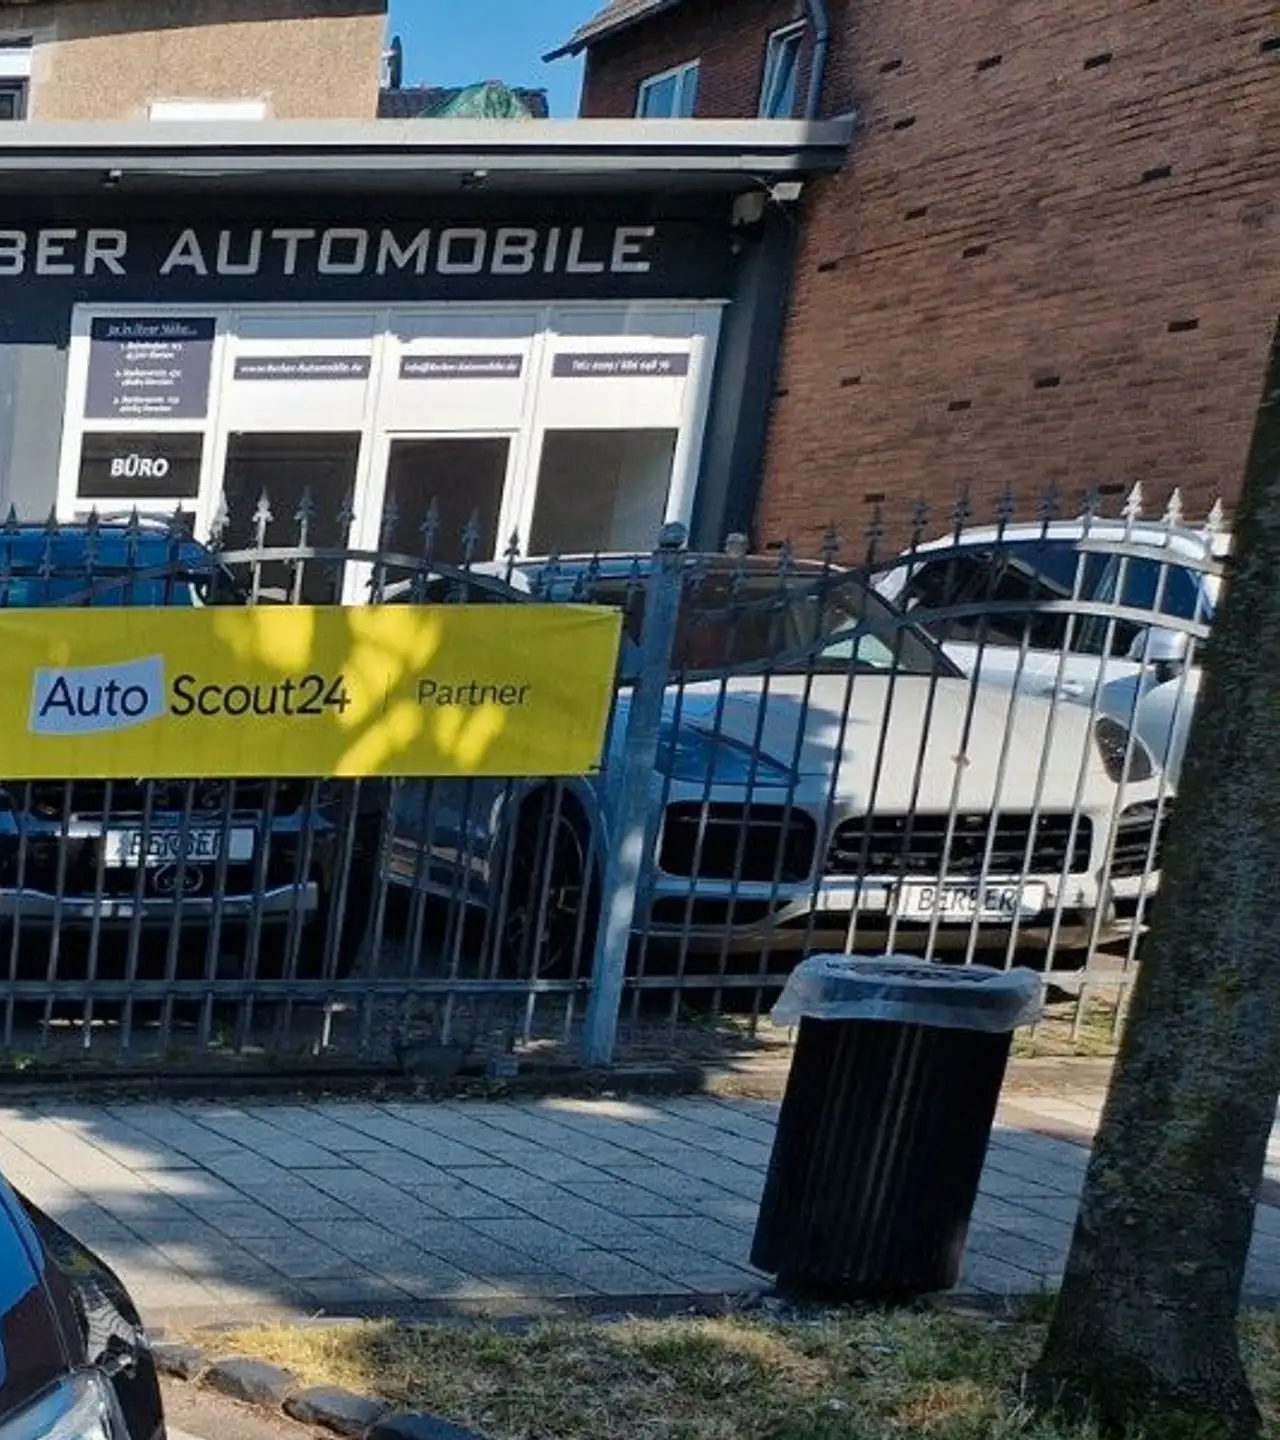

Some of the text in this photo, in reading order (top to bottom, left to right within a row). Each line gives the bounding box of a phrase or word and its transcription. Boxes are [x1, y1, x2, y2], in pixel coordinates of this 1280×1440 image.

[158, 225, 657, 276] AUTOMOBILE
[109, 453, 170, 478] BÜRO
[39, 673, 532, 717] Auto Scout24 Partner
